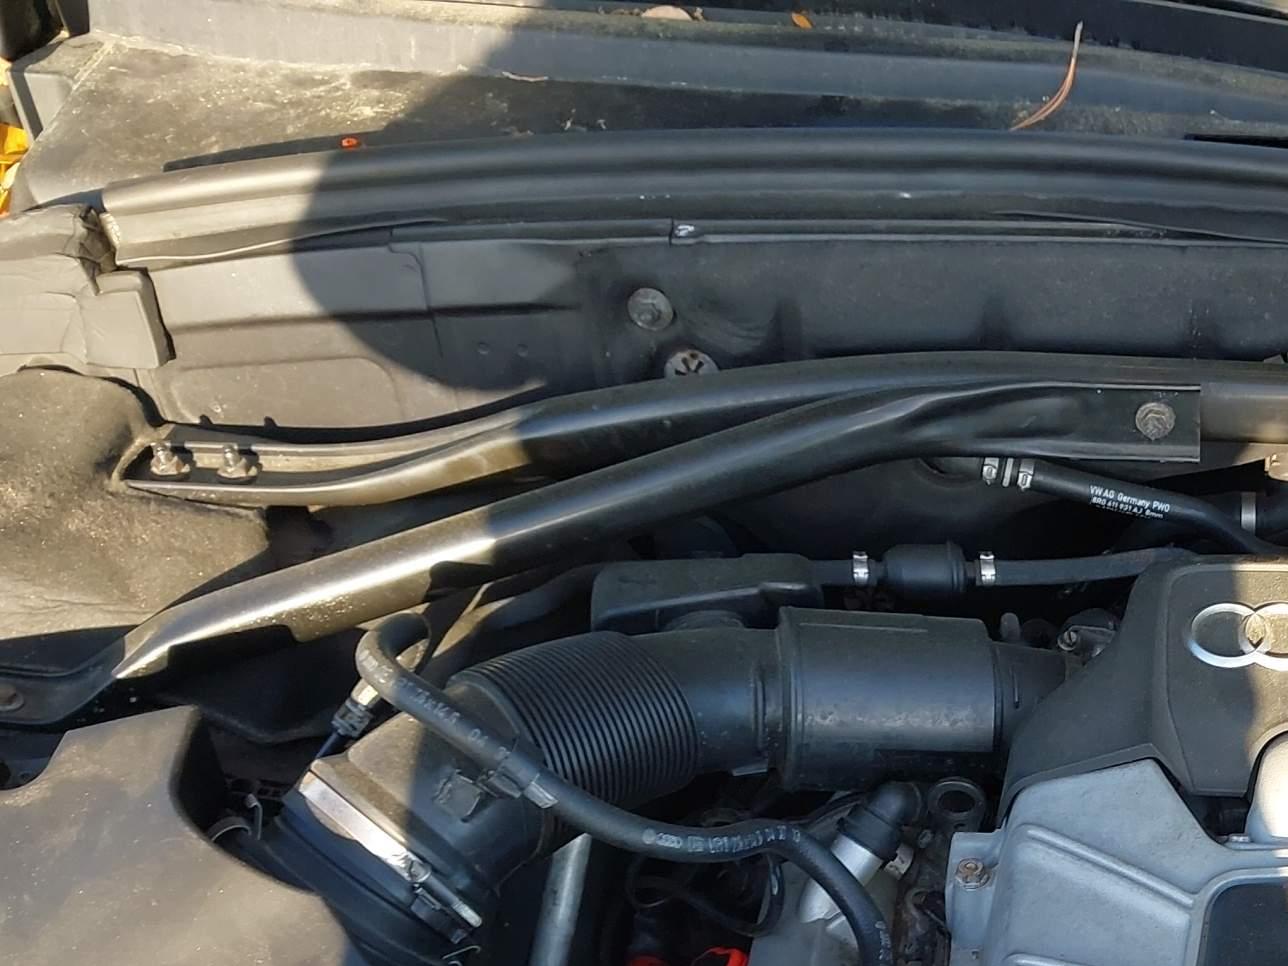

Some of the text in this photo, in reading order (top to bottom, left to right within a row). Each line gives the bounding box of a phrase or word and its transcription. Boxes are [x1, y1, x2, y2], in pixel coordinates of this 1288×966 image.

[1090, 485, 1103, 495] VW
[1103, 489, 1115, 499] AG
[1117, 493, 1150, 509] Germany
